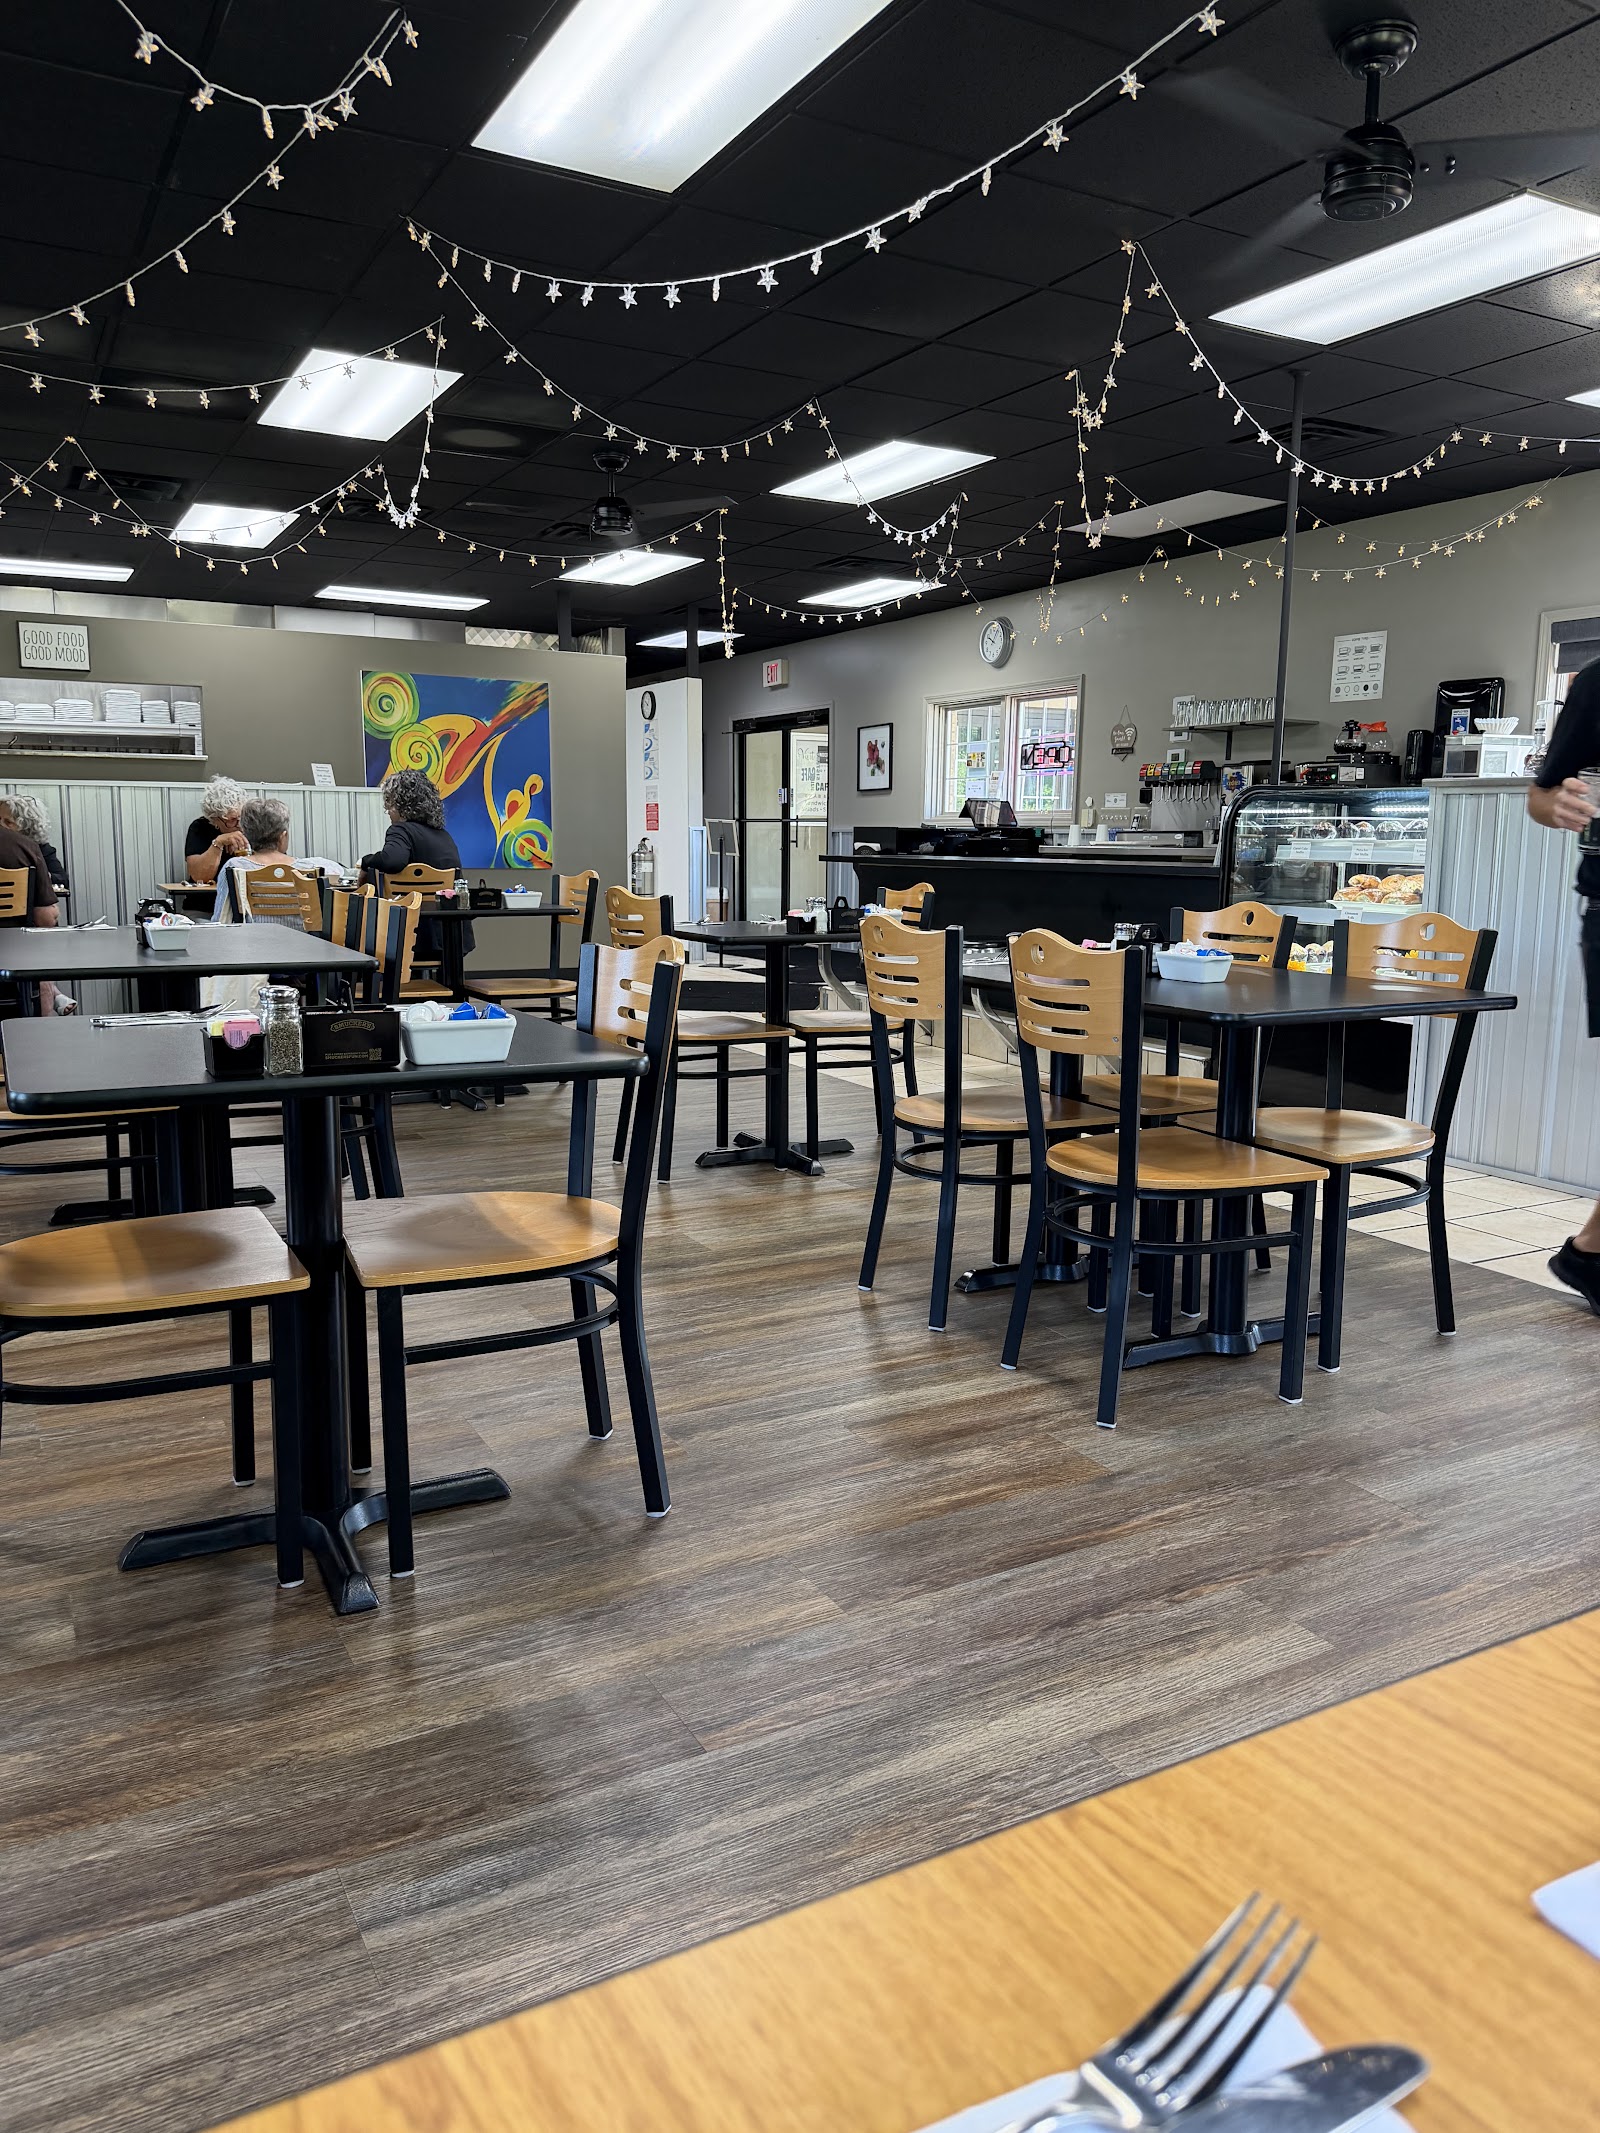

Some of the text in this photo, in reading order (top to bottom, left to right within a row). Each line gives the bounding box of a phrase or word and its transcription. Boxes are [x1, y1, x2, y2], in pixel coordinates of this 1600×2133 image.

[23, 629, 85, 647] GOOD FOOD
[24, 645, 86, 663] GOOD MOOD
[767, 663, 778, 684] EXIT
[815, 782, 828, 791] CAF
